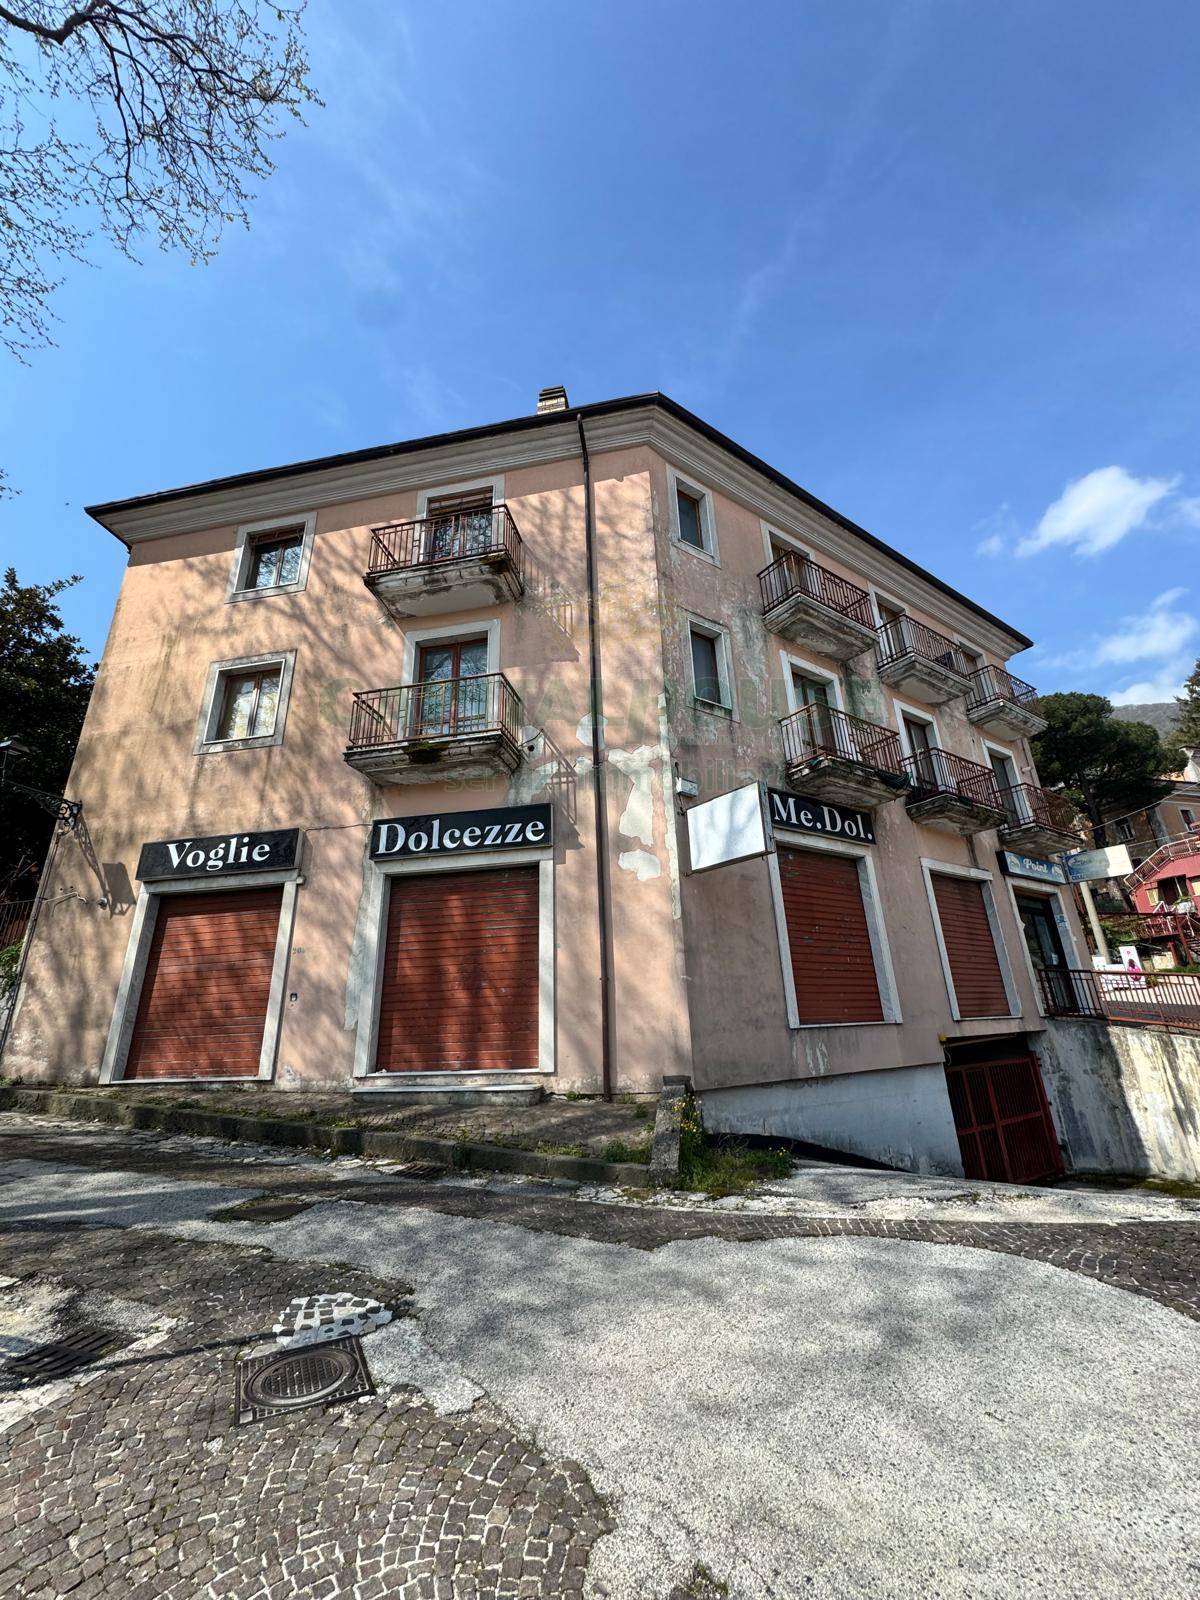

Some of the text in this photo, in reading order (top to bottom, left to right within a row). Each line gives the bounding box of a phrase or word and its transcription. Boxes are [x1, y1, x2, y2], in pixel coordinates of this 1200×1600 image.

[771, 793, 873, 840] Me.Dol.
[166, 836, 271, 871] Voglie
[375, 818, 546, 854] Dolcezze
[1022, 857, 1049, 873] Point
